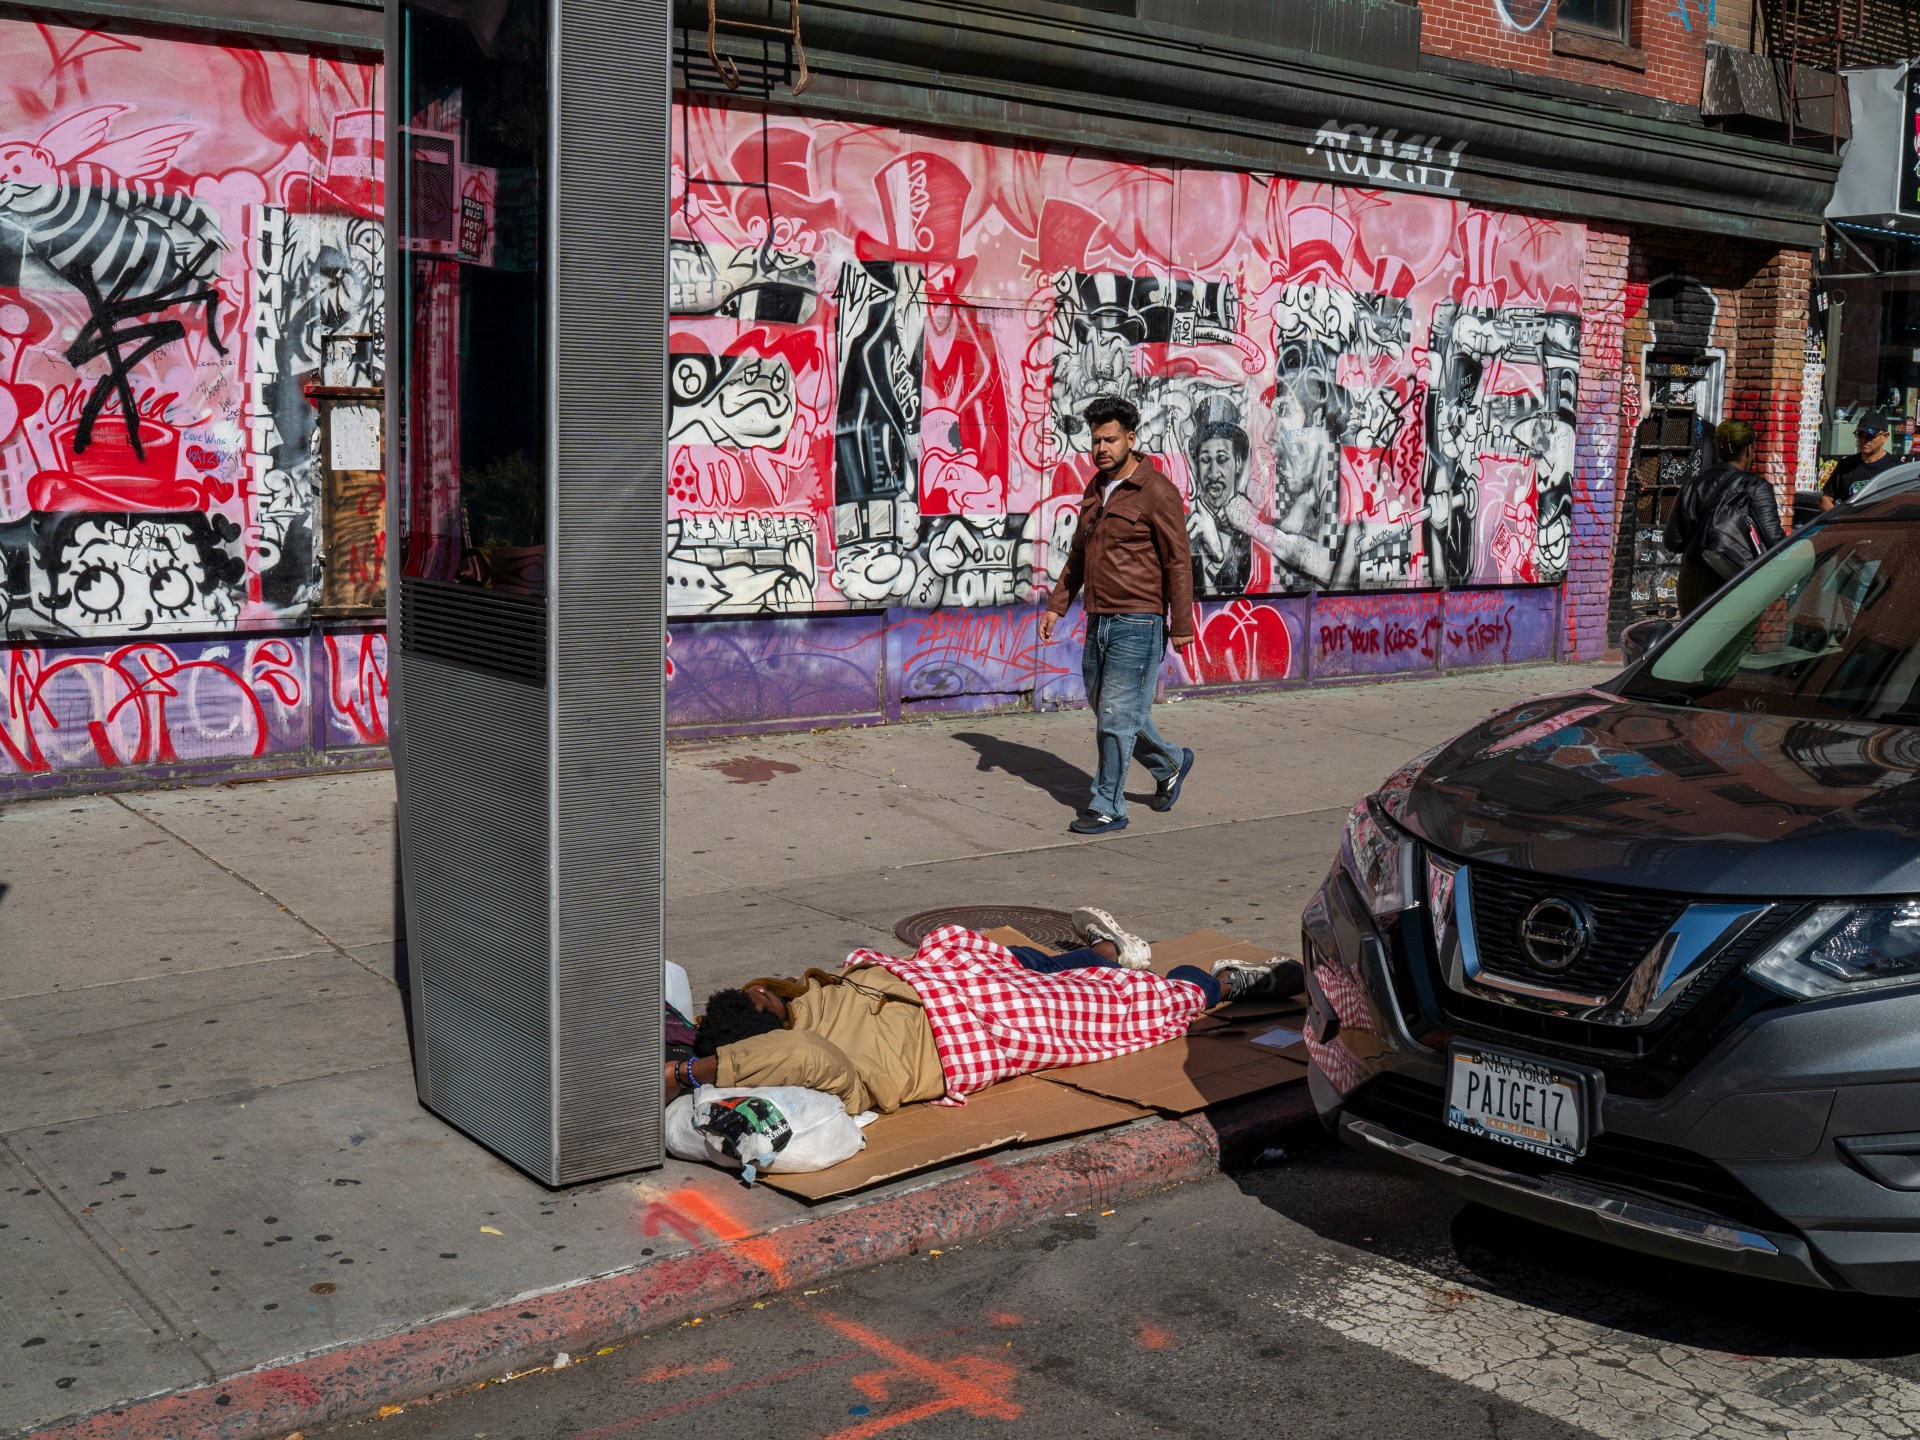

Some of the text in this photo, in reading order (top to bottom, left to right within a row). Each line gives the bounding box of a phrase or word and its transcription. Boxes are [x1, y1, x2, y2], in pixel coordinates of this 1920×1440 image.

[1516, 330, 1540, 344] ACME
[944, 571, 1016, 607] LOVE
[1320, 623, 1346, 656] PUT
[1347, 625, 1381, 655] YOUR
[1480, 1052, 1550, 1074] NISSAN
[1485, 1060, 1551, 1086] NEW YORK
[1466, 1070, 1564, 1132] PAIGE17
[1448, 1119, 1576, 1164] NEW ROCHELLE
[1484, 1116, 1548, 1142] EXCELSIOR
